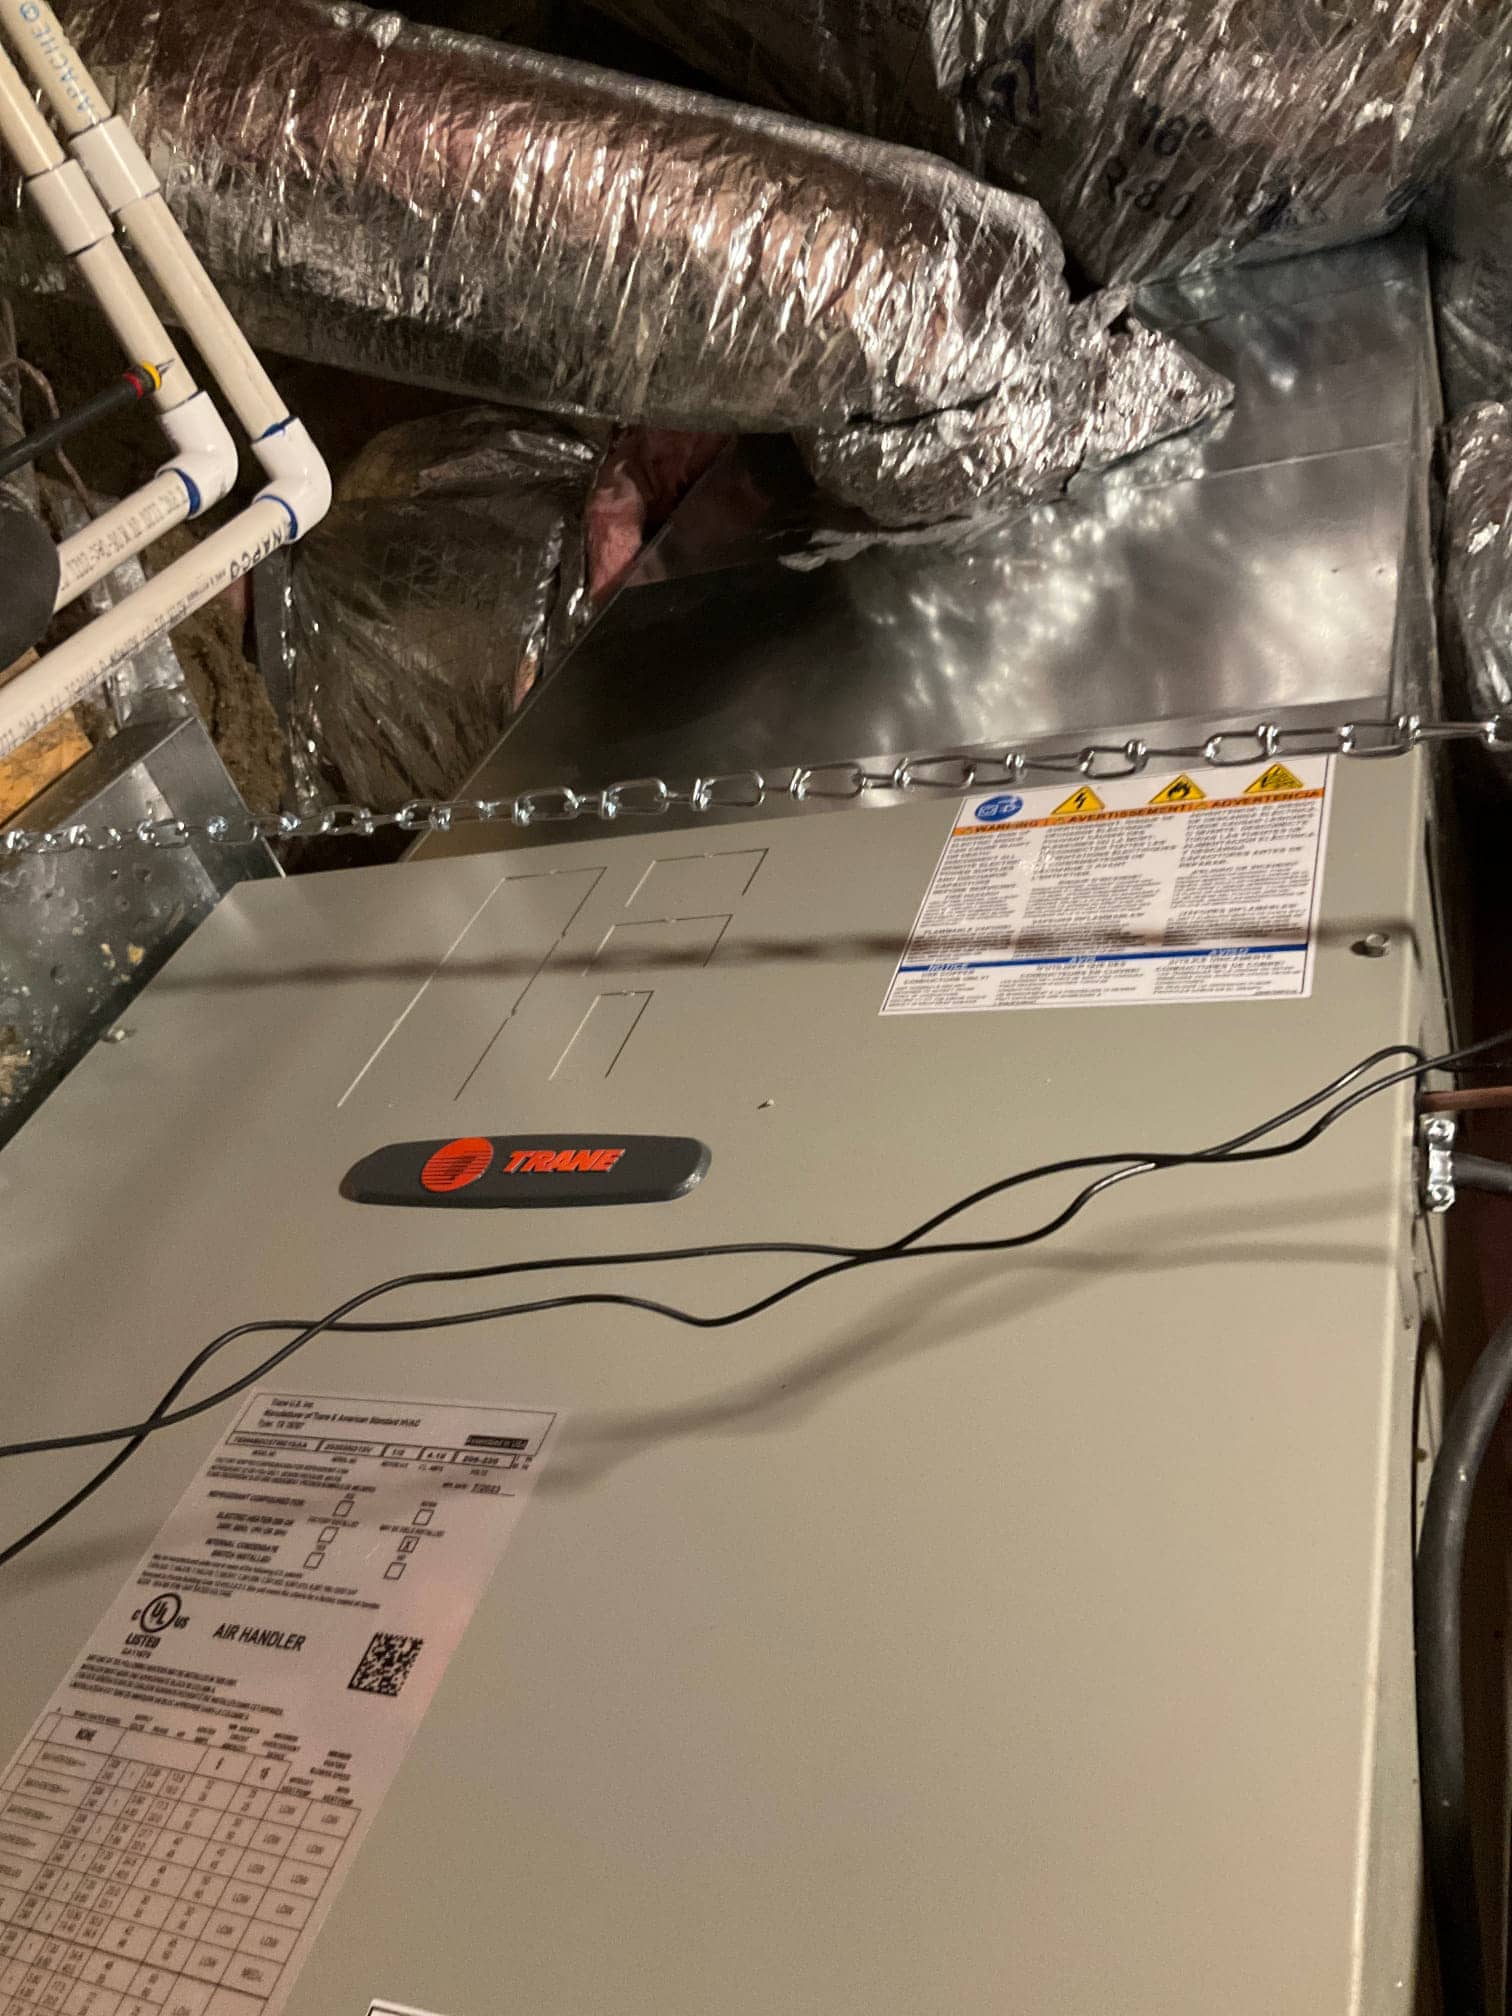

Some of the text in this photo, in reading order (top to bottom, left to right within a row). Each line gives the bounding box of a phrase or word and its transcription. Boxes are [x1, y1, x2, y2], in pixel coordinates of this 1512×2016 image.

[503, 1149, 626, 1173] TRANE
[212, 1622, 307, 1652] AIR HANDLER
